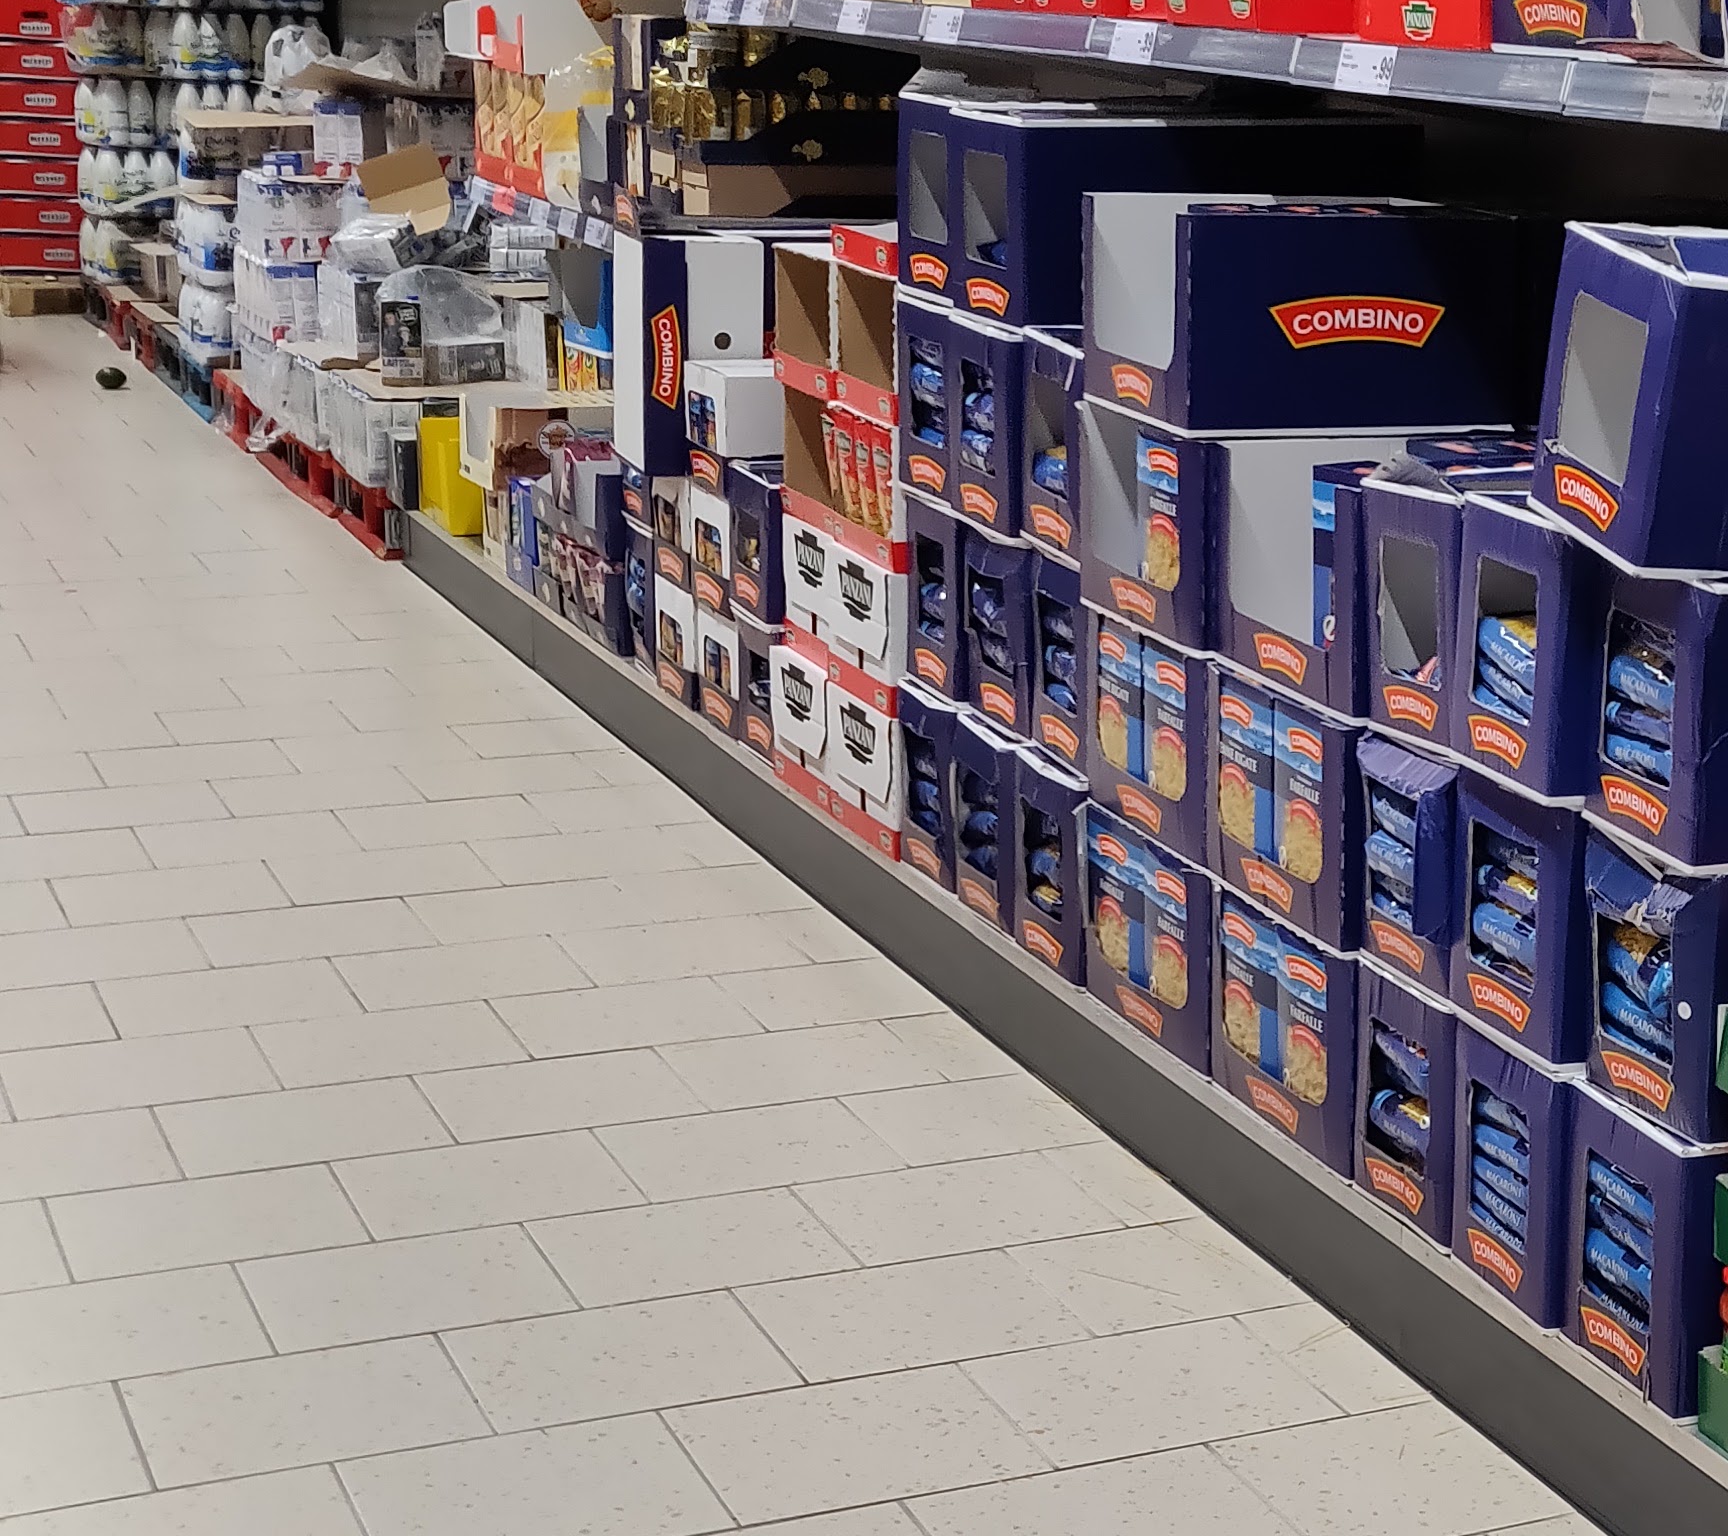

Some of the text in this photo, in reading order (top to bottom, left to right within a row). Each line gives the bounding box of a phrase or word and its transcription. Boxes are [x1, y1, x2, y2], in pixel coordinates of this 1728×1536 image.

[1404, 13, 1432, 31] PANZANI
[1293, 309, 1423, 334] COMBINO
[658, 317, 674, 398] COMBINO
[1560, 476, 1609, 519] COMBINO
[797, 545, 823, 578] PANZANI
[841, 575, 873, 608] PANZANI
[784, 677, 811, 710] PANZANI
[1619, 672, 1661, 701] MACARONI
[843, 719, 874, 750] PANZANI
[1608, 787, 1661, 828] COMBINO
[1482, 921, 1521, 951] MACARONI
[1289, 1004, 1324, 1033] FARFALLE
[1475, 985, 1526, 1025] COMBINO
[1619, 1008, 1664, 1040] MACARONI
[1486, 1169, 1522, 1198] MACARONI
[1596, 1170, 1635, 1207] MACARONI
[1485, 1191, 1522, 1226] MACARONI
[1587, 1320, 1639, 1367] COMBINO
